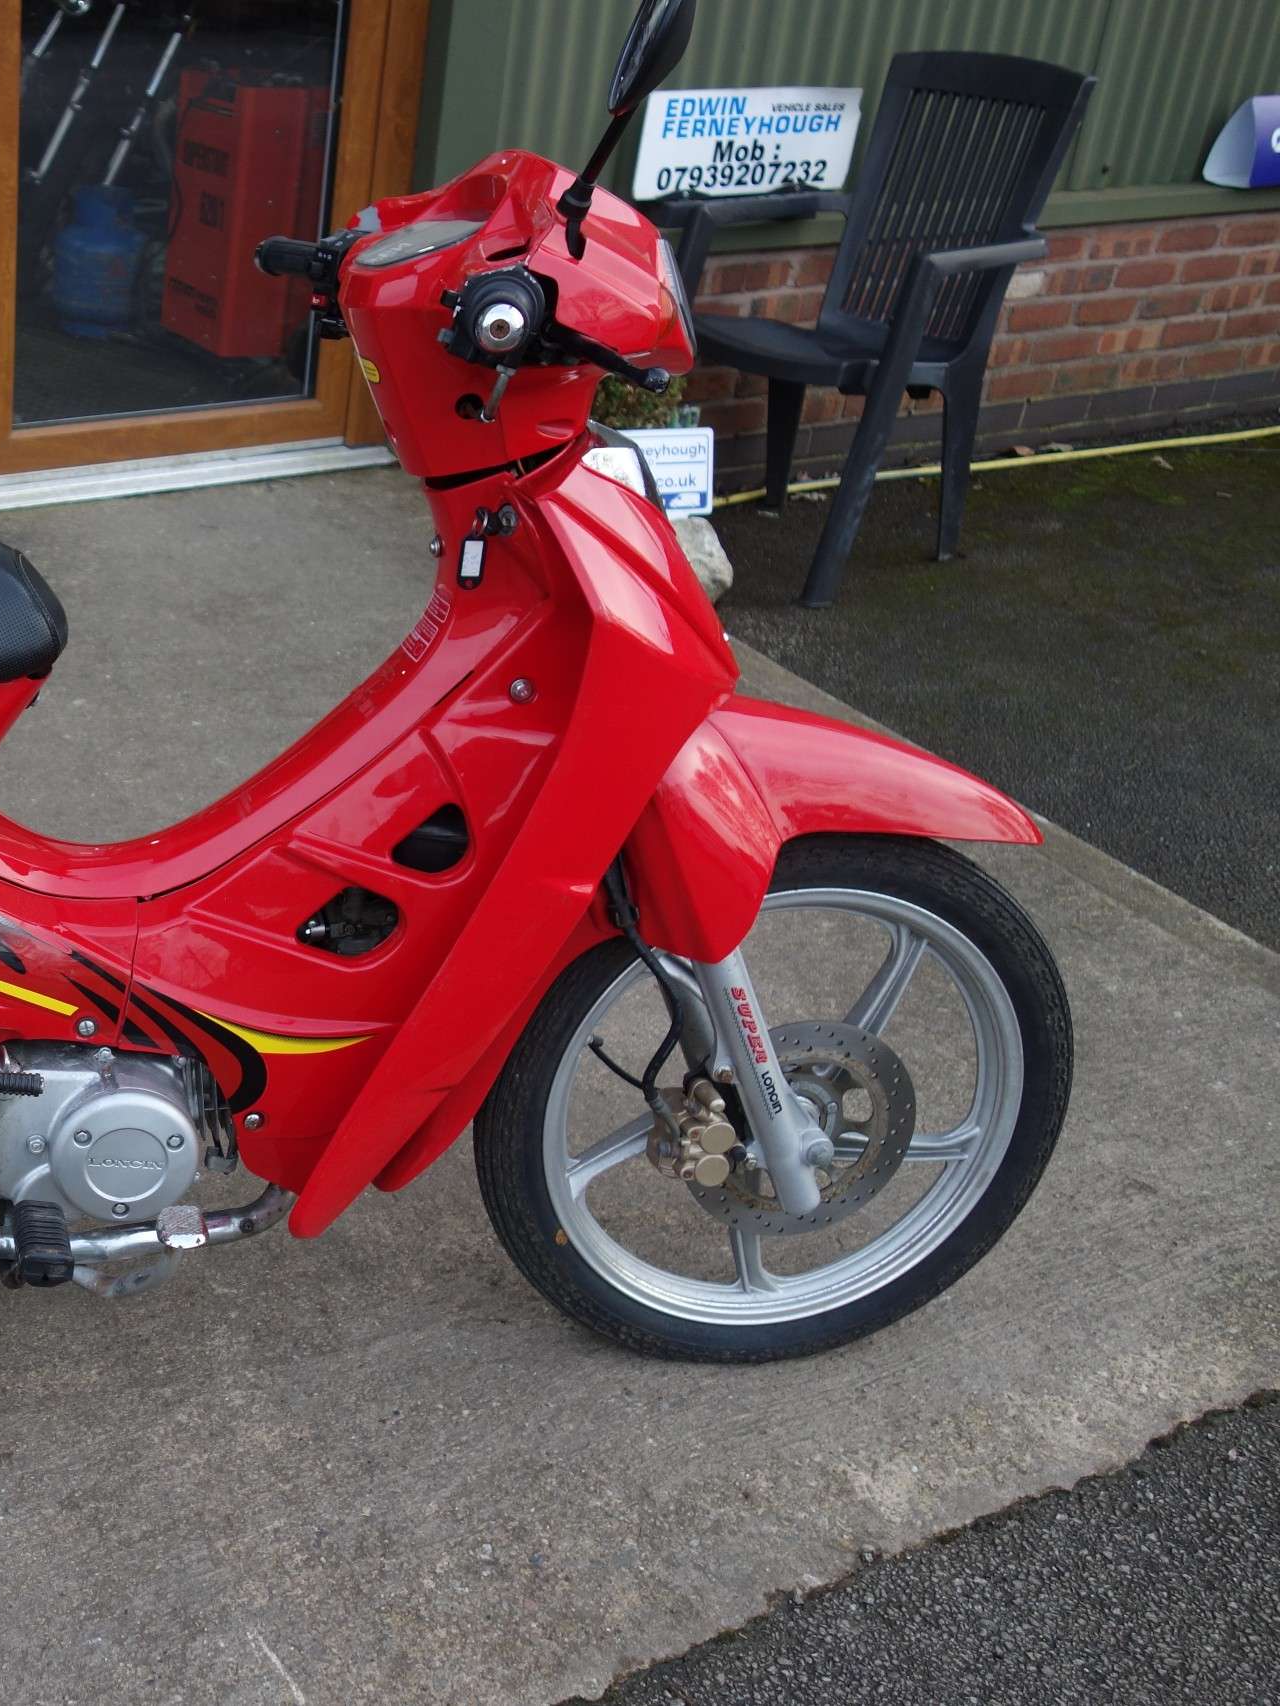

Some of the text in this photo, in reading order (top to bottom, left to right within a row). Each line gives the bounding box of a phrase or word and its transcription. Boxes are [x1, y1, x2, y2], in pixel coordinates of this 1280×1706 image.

[666, 97, 747, 118] EDWIN
[772, 103, 846, 112] VEHICLE SALES
[662, 115, 841, 139] FERNEYHOUGH
[713, 140, 765, 162] Mob
[657, 160, 828, 190] 07939207232
[730, 986, 769, 1064] SUPER
[88, 1157, 165, 1170] LONCIN
